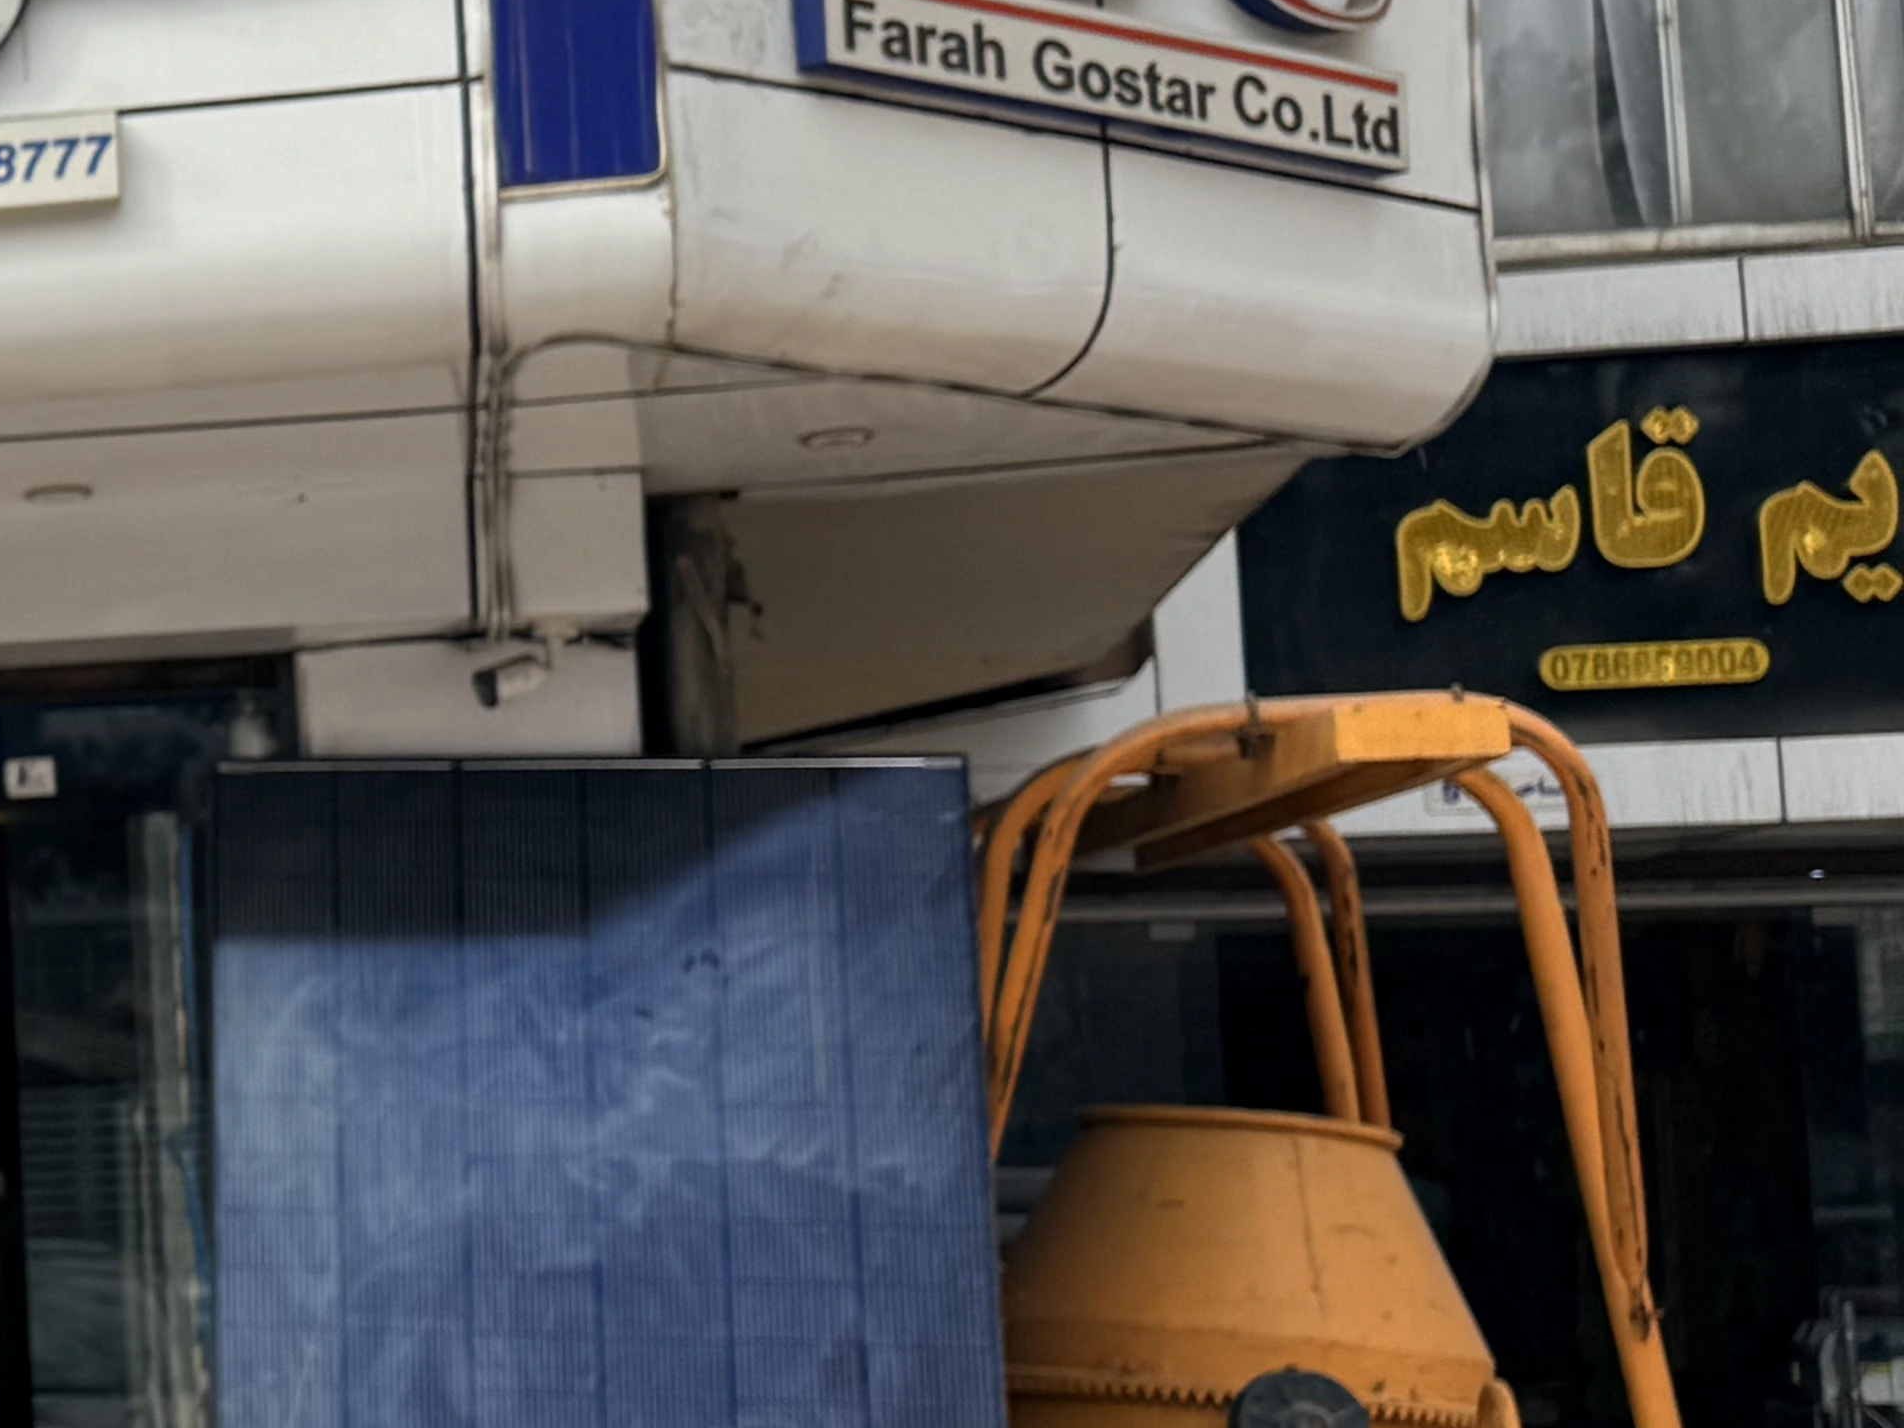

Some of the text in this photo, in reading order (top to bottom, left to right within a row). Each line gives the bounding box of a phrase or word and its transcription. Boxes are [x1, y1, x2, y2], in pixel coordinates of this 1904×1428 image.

[1032, 39, 1215, 121] Gostar
[1232, 75, 1400, 156] Co.Ltd
[1396, 406, 1705, 622] قاسم
